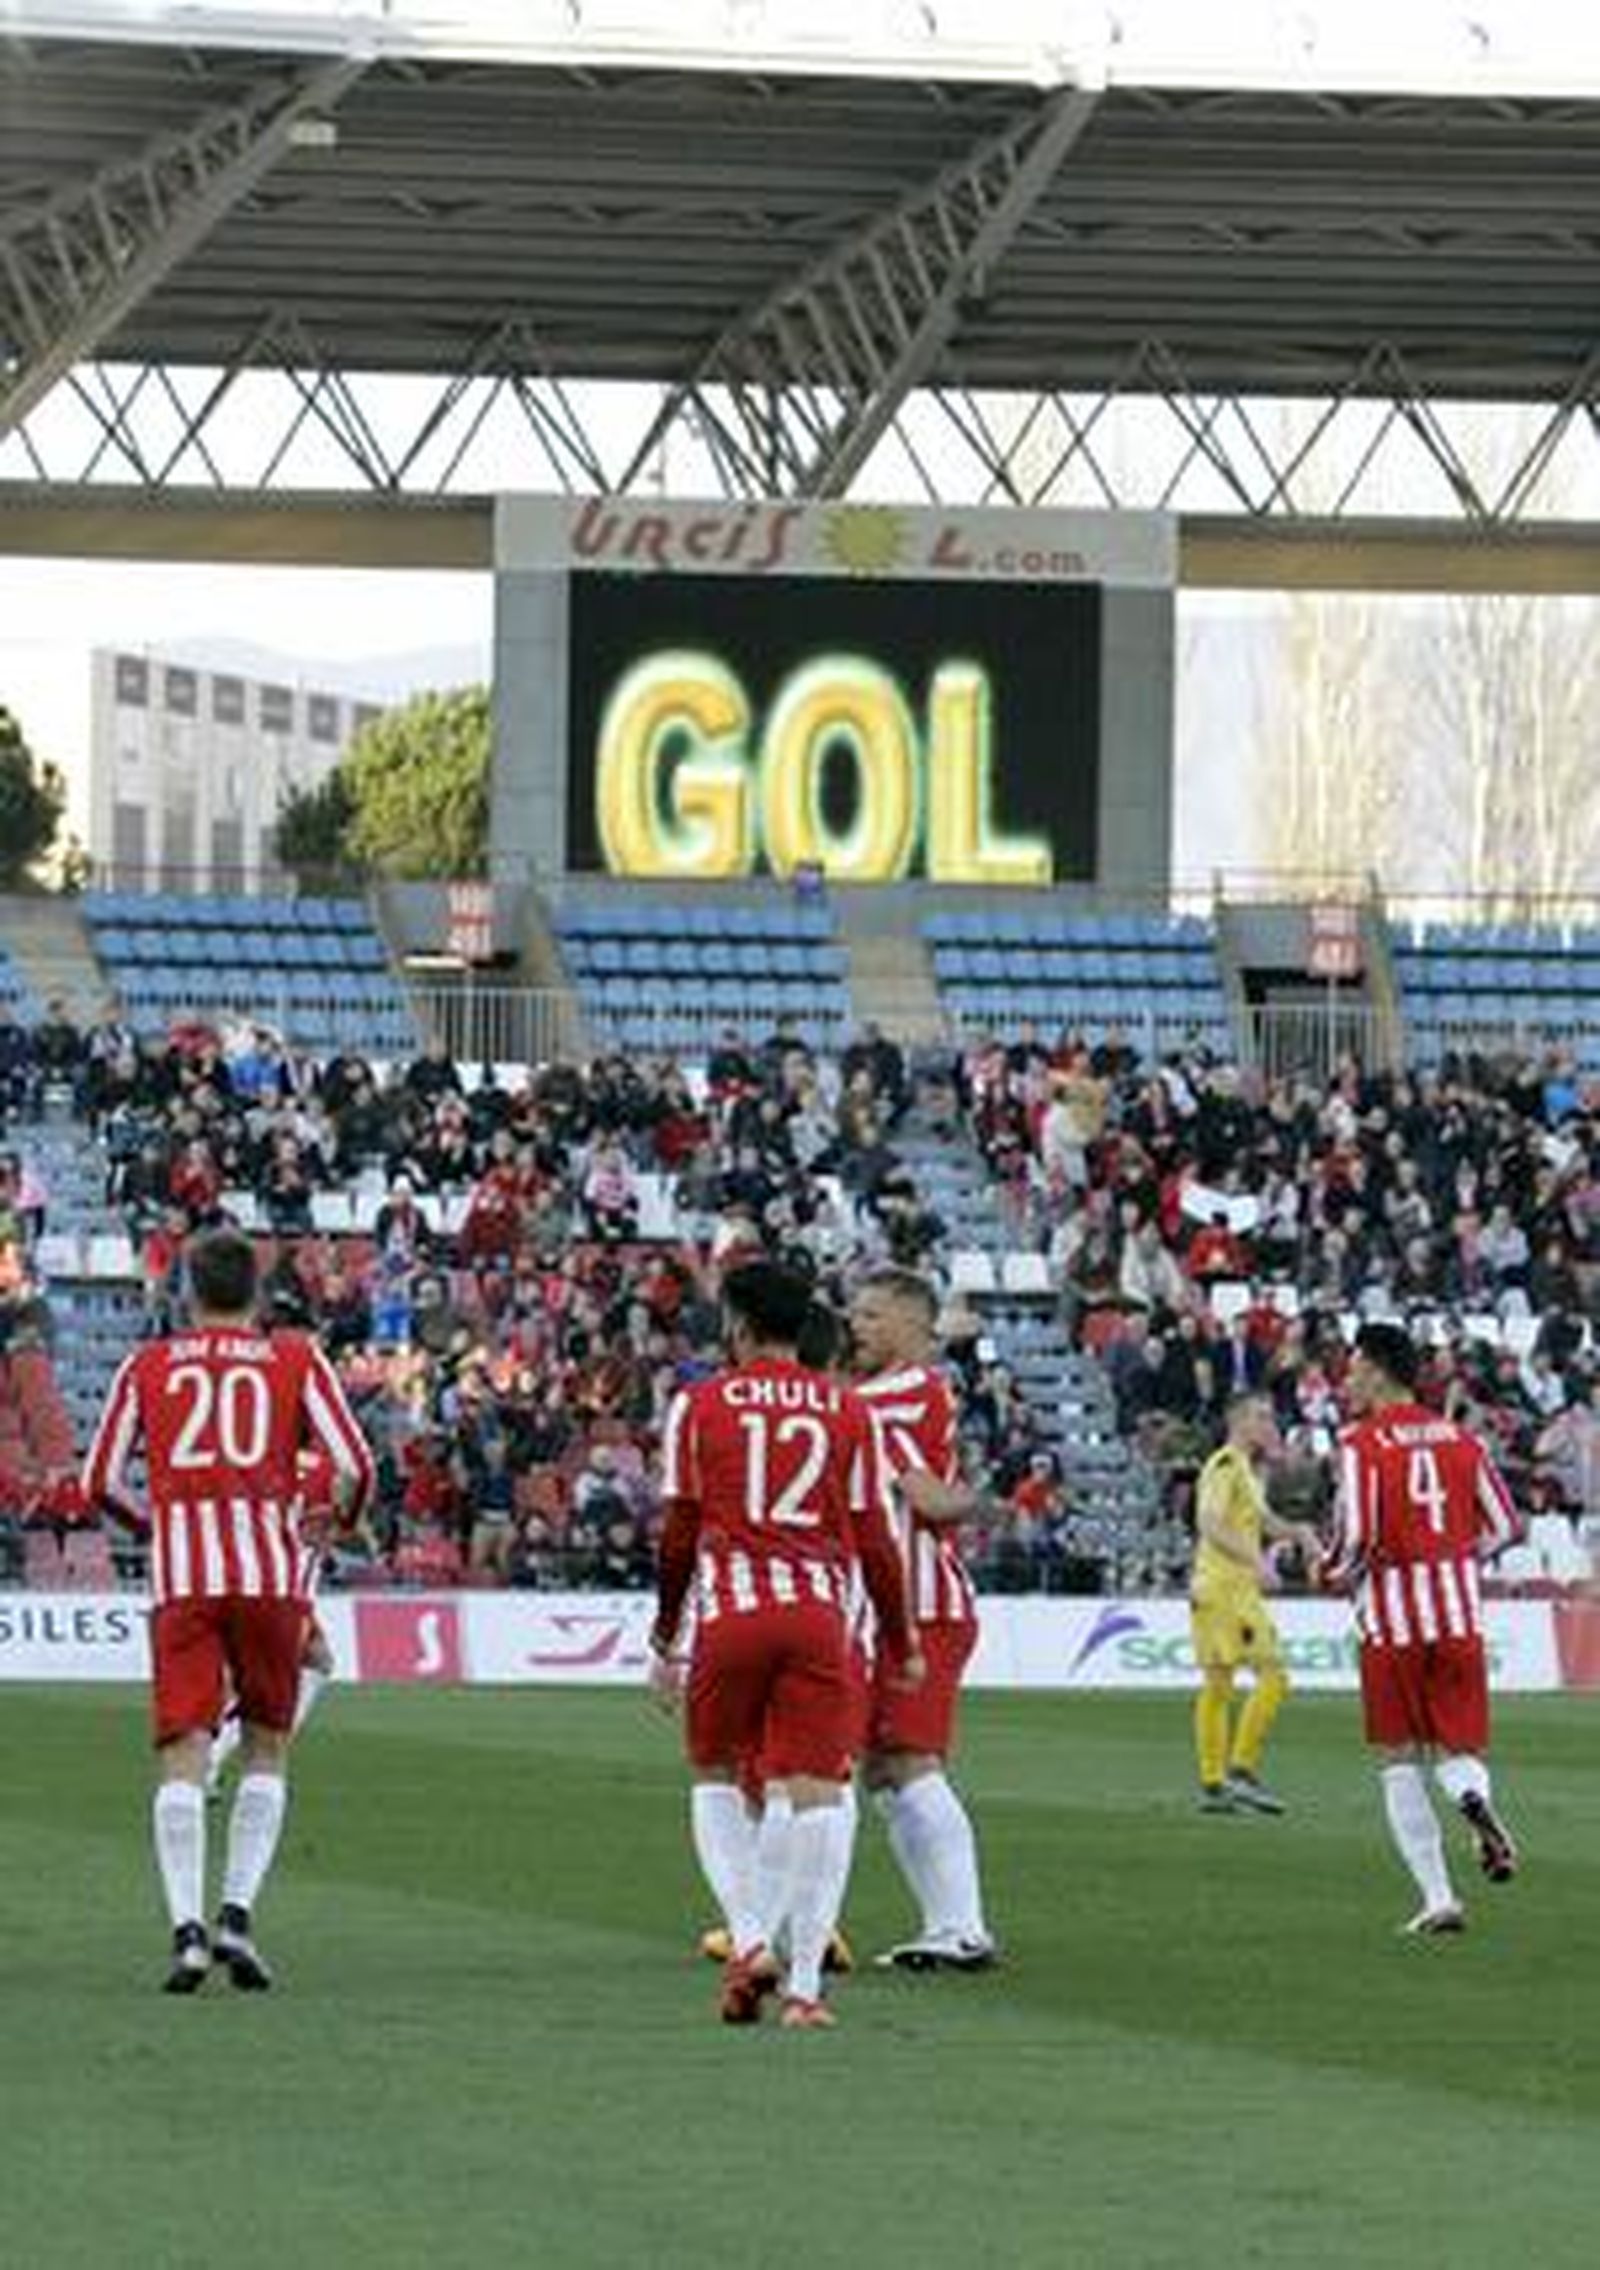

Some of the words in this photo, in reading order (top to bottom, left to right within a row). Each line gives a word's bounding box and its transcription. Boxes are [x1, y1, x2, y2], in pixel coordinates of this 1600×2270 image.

[596, 650, 1052, 885] GOL
[166, 1364, 269, 1468] 20
[723, 1378, 840, 1413] CHULI
[740, 1412, 828, 1526] 12
[1408, 1447, 1446, 1533] 4
